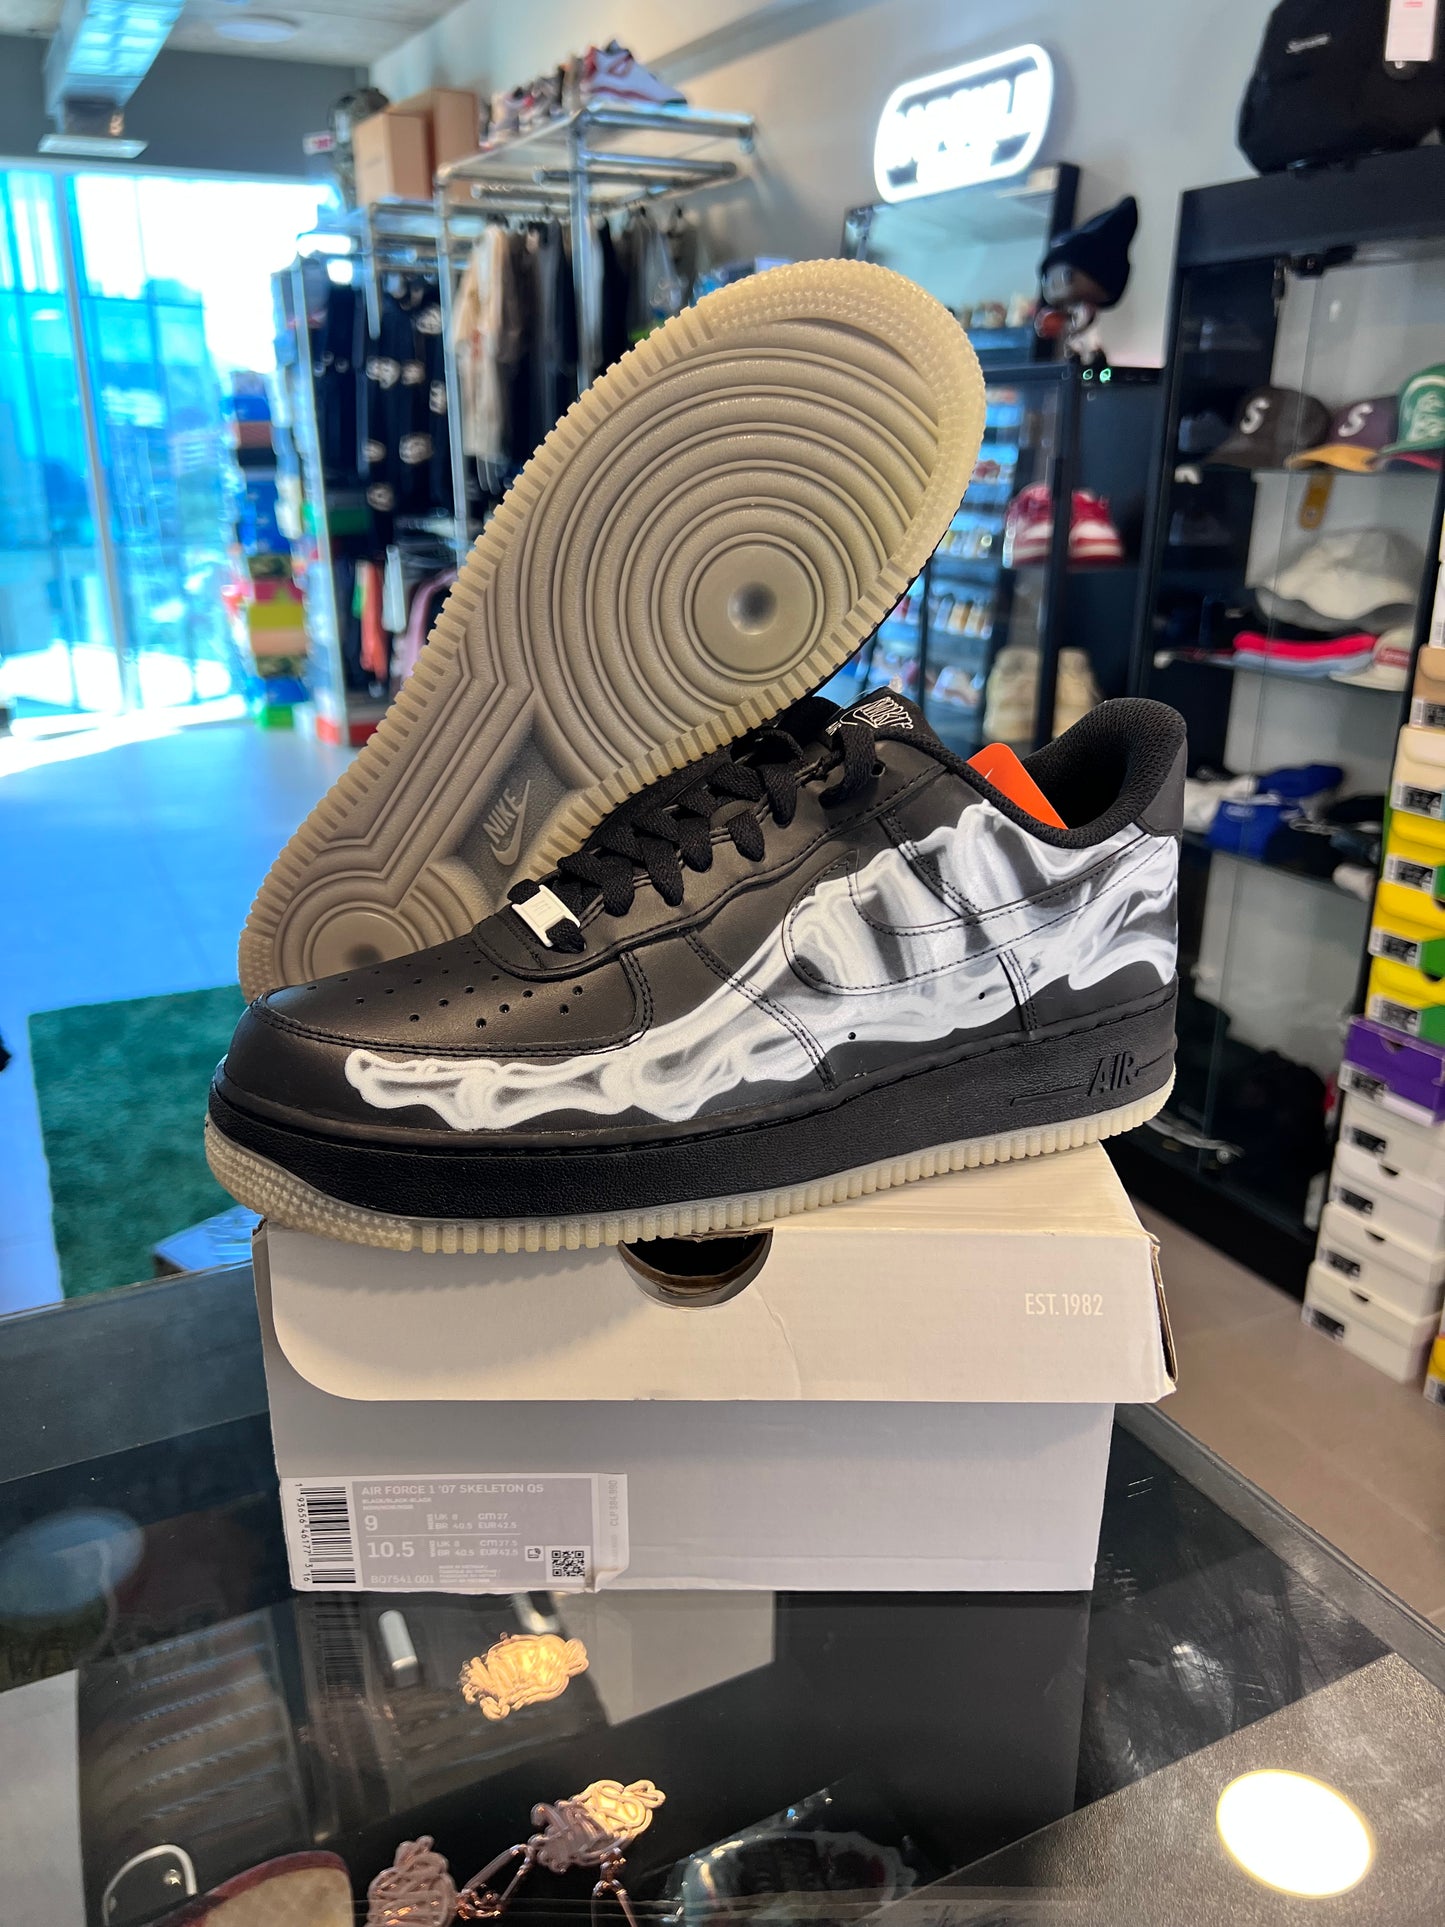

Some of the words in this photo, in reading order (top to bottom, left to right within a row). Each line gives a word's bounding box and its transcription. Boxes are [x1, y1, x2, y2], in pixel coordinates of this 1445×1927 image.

[1240, 397, 1270, 435] S
[1338, 402, 1374, 438] S
[482, 787, 523, 845] NIKE
[1087, 1051, 1137, 1097] AIR
[361, 1486, 382, 1495] AIR
[384, 1485, 426, 1495] FORCE
[429, 1484, 436, 1494] 1
[438, 1484, 457, 1494] '07
[460, 1483, 525, 1493] SKELETON
[526, 1483, 545, 1493] QS
[296, 1497, 307, 1524] 93656
[364, 1514, 378, 1531] 9
[301, 1528, 312, 1554] 46177
[367, 1541, 415, 1558] 10.5
[303, 1573, 312, 1582] 16
[414, 1575, 434, 1584] 001
